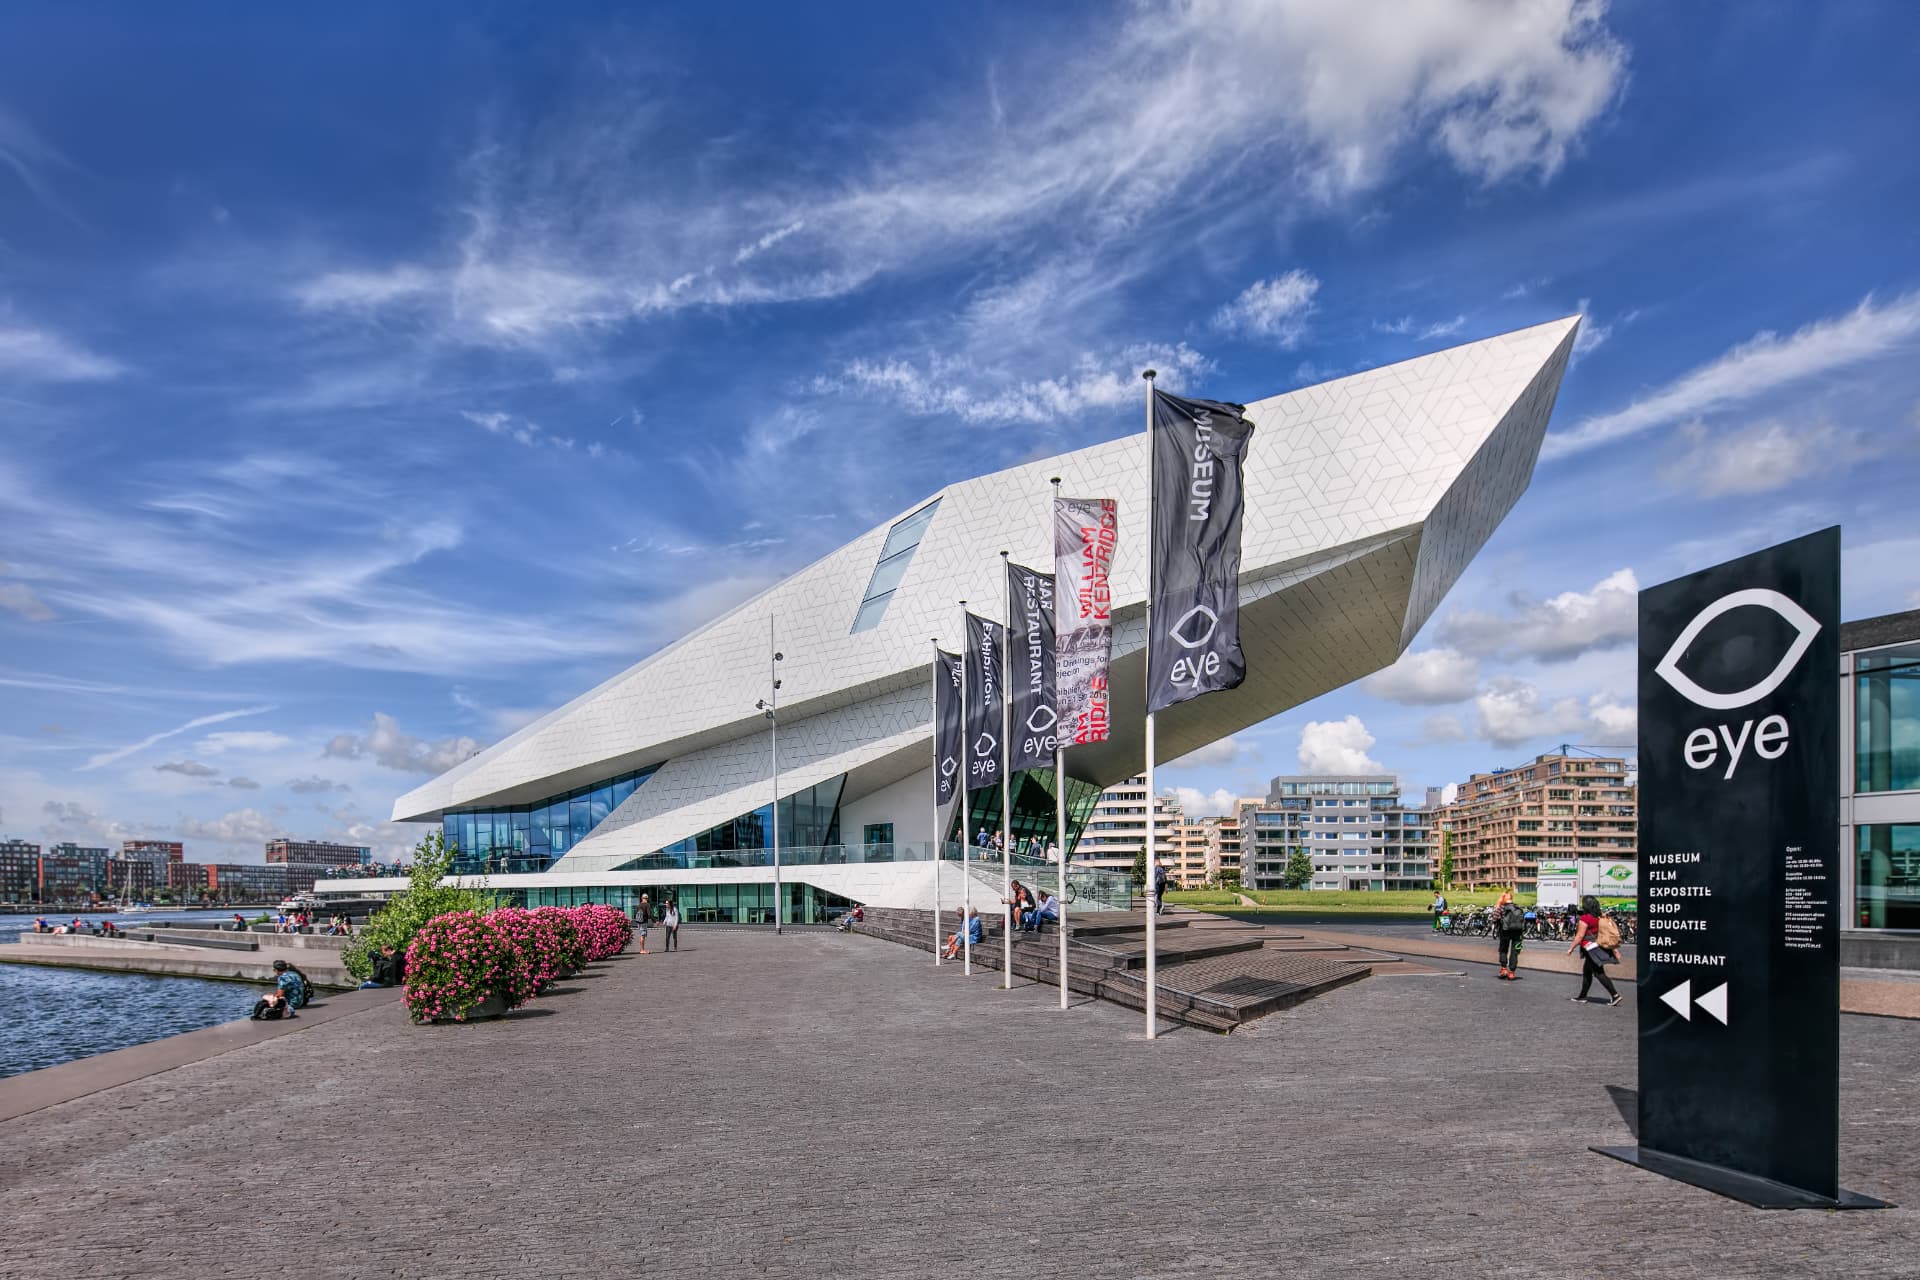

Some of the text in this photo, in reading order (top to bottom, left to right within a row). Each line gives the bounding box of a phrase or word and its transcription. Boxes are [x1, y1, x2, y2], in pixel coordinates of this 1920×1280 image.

[1190, 407, 1214, 521] MUSEUM
[1068, 502, 1091, 516] eye
[1094, 498, 1116, 620] KENTRIDGE
[1080, 527, 1097, 618] WILLIAM
[1170, 650, 1220, 689] eye
[1023, 734, 1058, 758] eye
[1683, 714, 1790, 780] eye
[972, 758, 996, 779] eye
[1649, 853, 1700, 865] MUSEUM
[1649, 871, 1677, 881] FILM
[1649, 886, 1712, 897] EXPOSITIE
[1649, 903, 1681, 913] SHOP
[1649, 920, 1707, 930] EDUCATIE
[1649, 936, 1677, 946] BAR-
[1649, 952, 1726, 967] RESTAURANT
